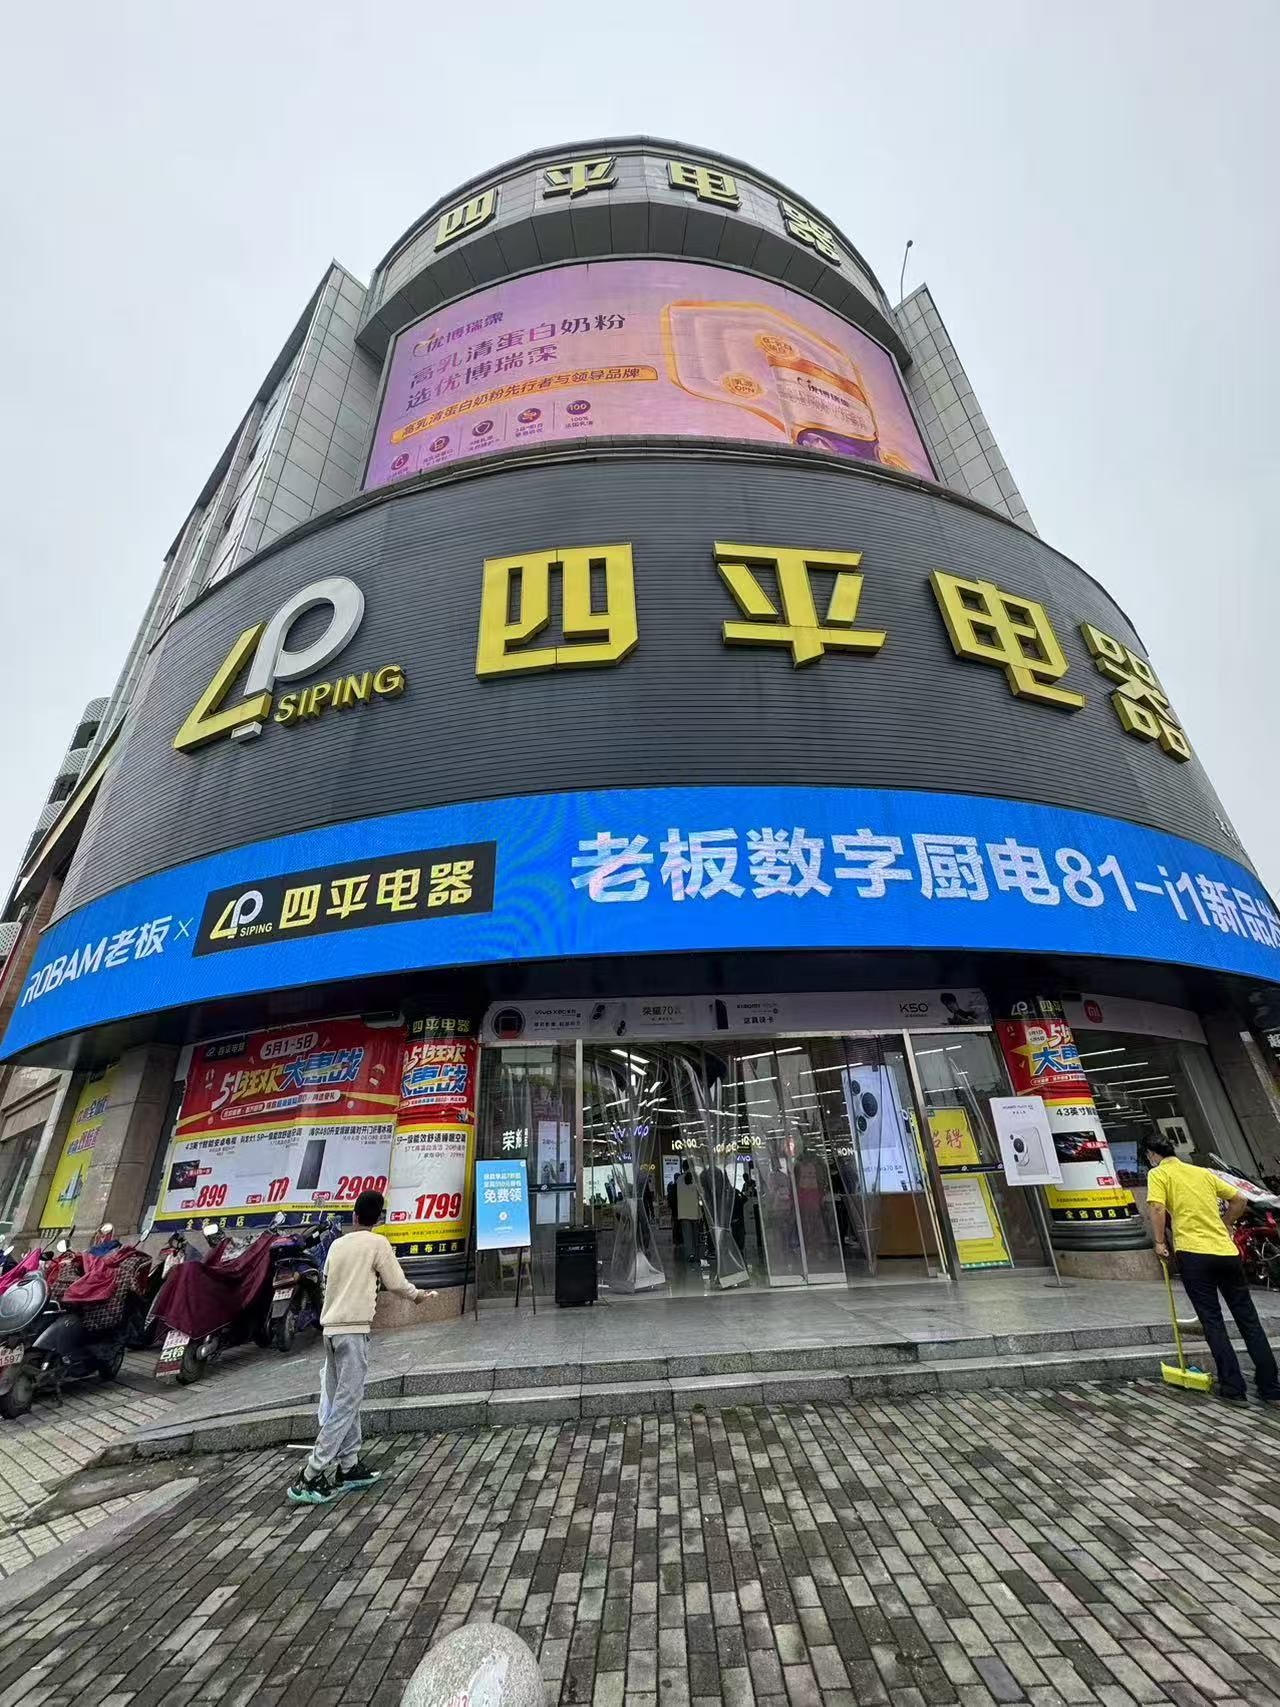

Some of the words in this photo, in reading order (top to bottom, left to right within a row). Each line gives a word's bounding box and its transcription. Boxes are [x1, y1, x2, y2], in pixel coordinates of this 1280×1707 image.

[434, 155, 841, 266] 四平电器
[409, 313, 626, 390] 高乳清蛋白奶粉
[474, 539, 1192, 764] 四平电器
[273, 664, 405, 727] SIPING
[278, 860, 476, 930] 四平电器
[239, 922, 273, 938] SIPING
[899, 1002, 929, 1013] K50
[411, 1017, 473, 1034] 四平电器
[264, 1033, 313, 1057] 5月1-5日
[197, 1183, 228, 1209] 899
[414, 1192, 463, 1220] 1799
[483, 1187, 523, 1204] 免费领
